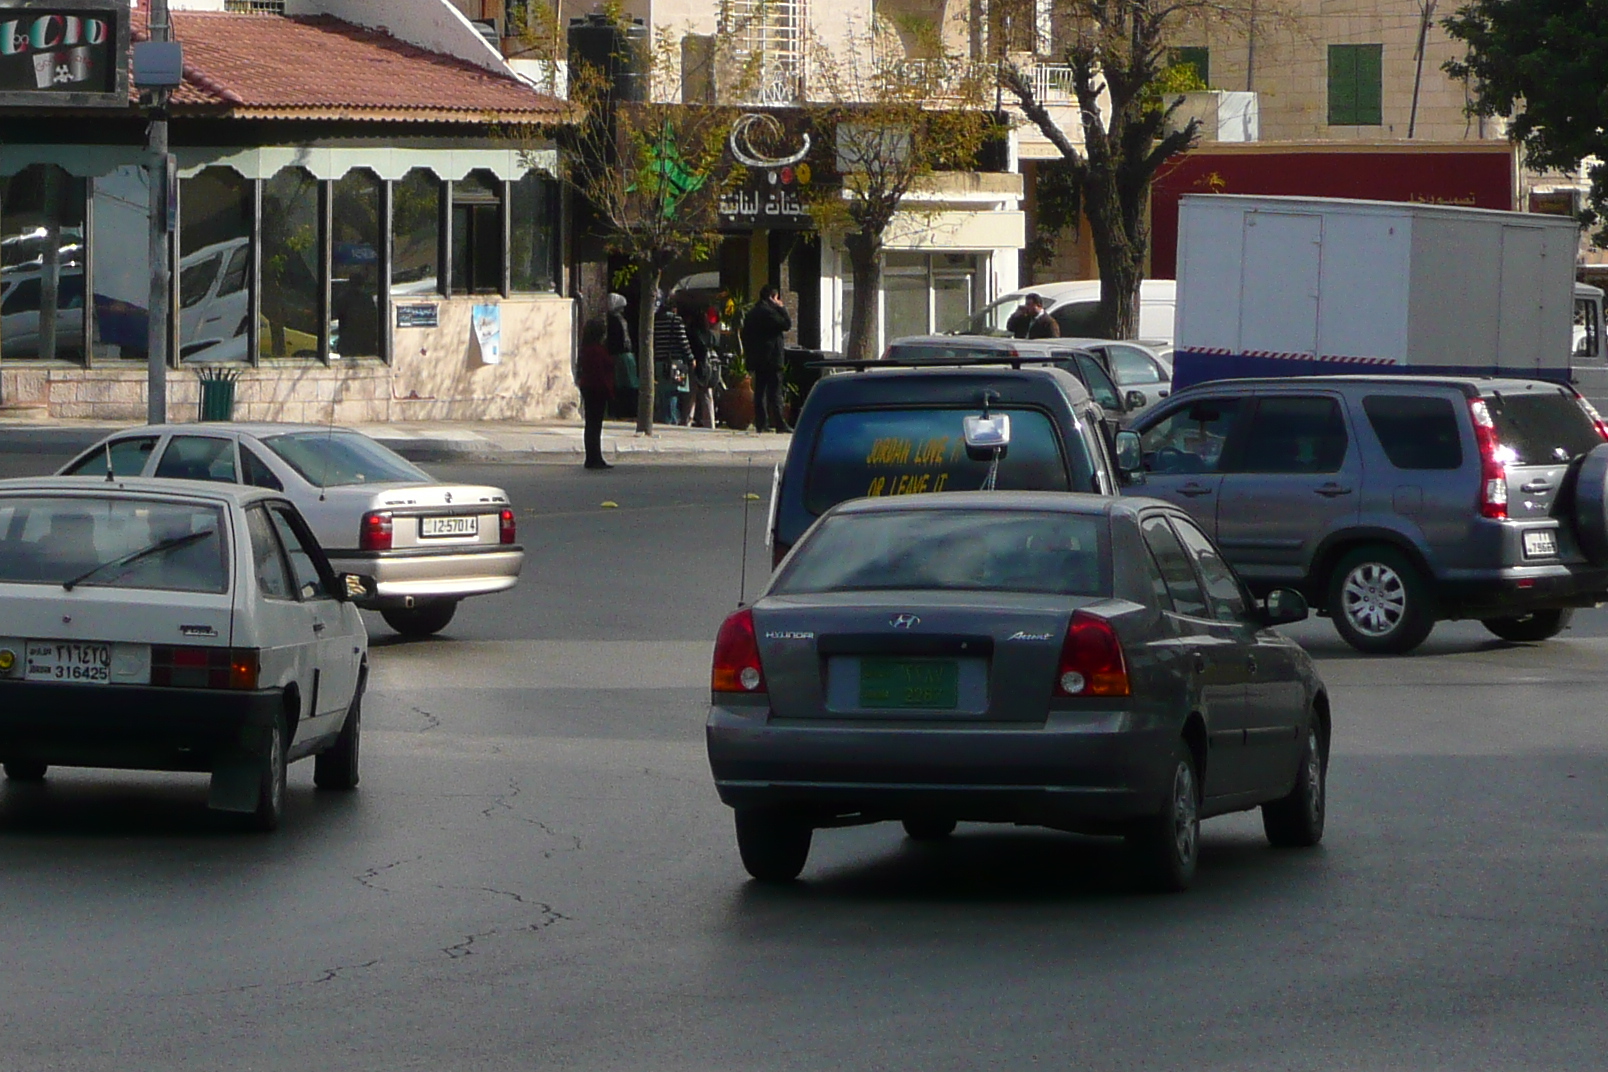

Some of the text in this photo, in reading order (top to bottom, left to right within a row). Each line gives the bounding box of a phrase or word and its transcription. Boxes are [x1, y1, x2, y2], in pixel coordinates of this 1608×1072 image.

[933, 472, 949, 493] IT
[433, 518, 475, 534] 12-57014
[766, 630, 814, 640] HYUNDAI
[55, 665, 108, 680] 316425
